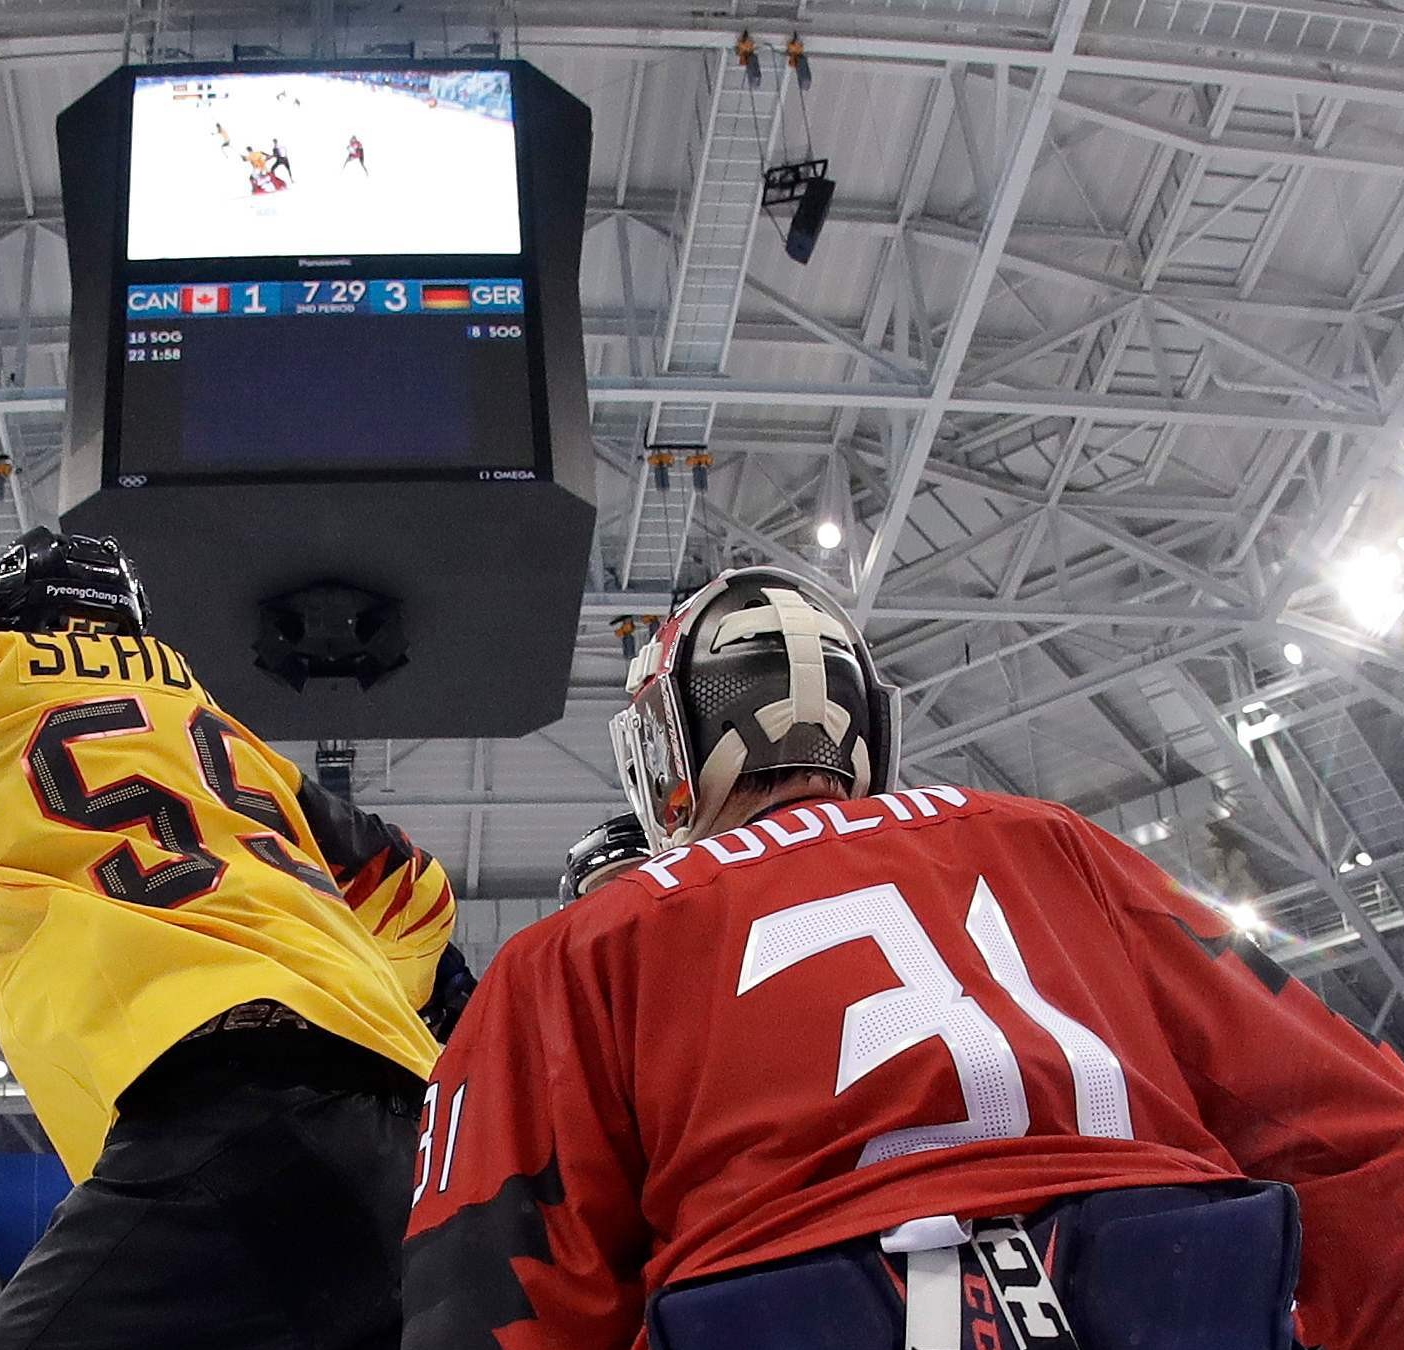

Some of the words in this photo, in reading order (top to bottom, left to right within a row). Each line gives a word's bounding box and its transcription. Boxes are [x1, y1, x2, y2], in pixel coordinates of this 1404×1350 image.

[128, 291, 178, 311] CAN
[244, 285, 267, 314] 1
[303, 281, 320, 303] 7
[331, 280, 366, 302] 29
[384, 282, 408, 312] 3
[472, 286, 521, 305] GER
[318, 304, 355, 314] PERIOD
[150, 331, 183, 343] SOG
[488, 326, 521, 338] SOG
[129, 349, 146, 362] 22
[151, 348, 181, 361] 1:58
[493, 470, 536, 480] OMEGA
[46, 585, 118, 605] PyeongChang
[638, 783, 968, 889] POULIN
[736, 874, 1135, 1170] 31
[411, 1081, 467, 1209] 31
